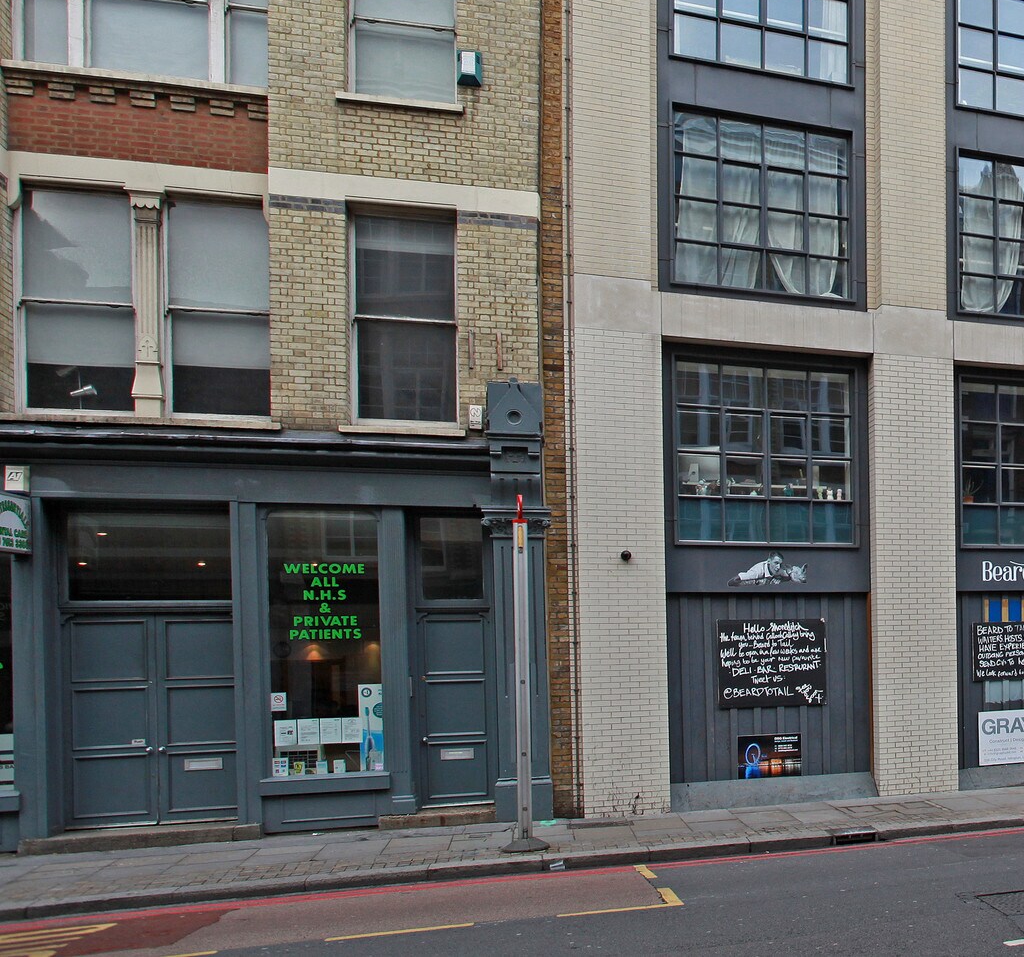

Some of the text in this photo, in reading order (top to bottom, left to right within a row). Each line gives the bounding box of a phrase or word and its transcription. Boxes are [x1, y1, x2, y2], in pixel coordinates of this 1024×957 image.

[283, 563, 365, 574] WELCOME
[310, 576, 339, 587] ALL
[303, 589, 347, 600] N.H.S
[319, 602, 331, 613] &
[293, 615, 358, 627] PRIVATE
[743, 622, 766, 633] Hello
[976, 625, 1004, 636] BEARD
[1004, 625, 1014, 633] TO
[289, 628, 362, 640] PATIENTS
[799, 645, 809, 653] and
[979, 644, 997, 653] HAVE
[979, 660, 996, 668] SEND
[1007, 657, 1015, 666] TO
[732, 667, 752, 677] DELI
[757, 665, 777, 674] BAR
[976, 669, 985, 678] We
[723, 686, 794, 700] @BEARDTOTAIL
